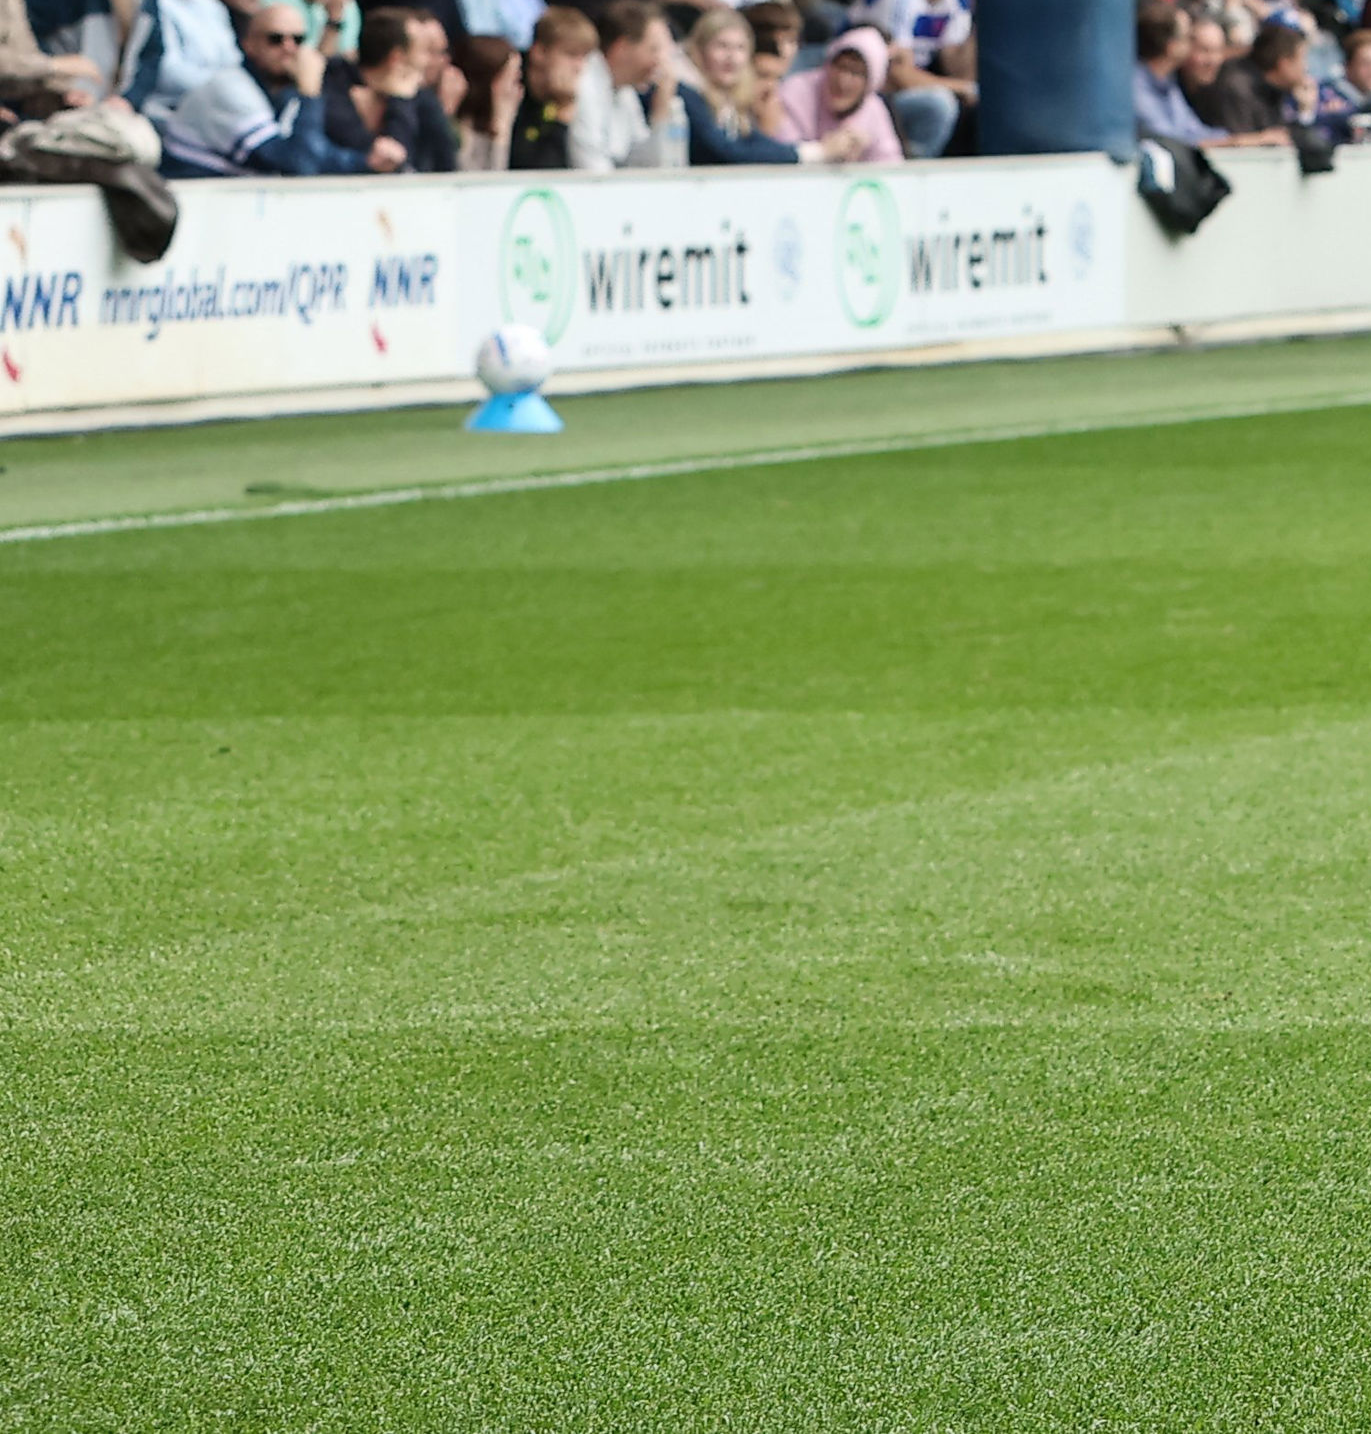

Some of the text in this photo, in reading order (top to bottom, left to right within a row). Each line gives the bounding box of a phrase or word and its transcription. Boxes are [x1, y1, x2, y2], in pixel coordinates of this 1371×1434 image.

[0, 272, 83, 332] NNR
[367, 253, 441, 308] NNR
[581, 218, 751, 311] wiremit
[904, 203, 1047, 294] wiremit
